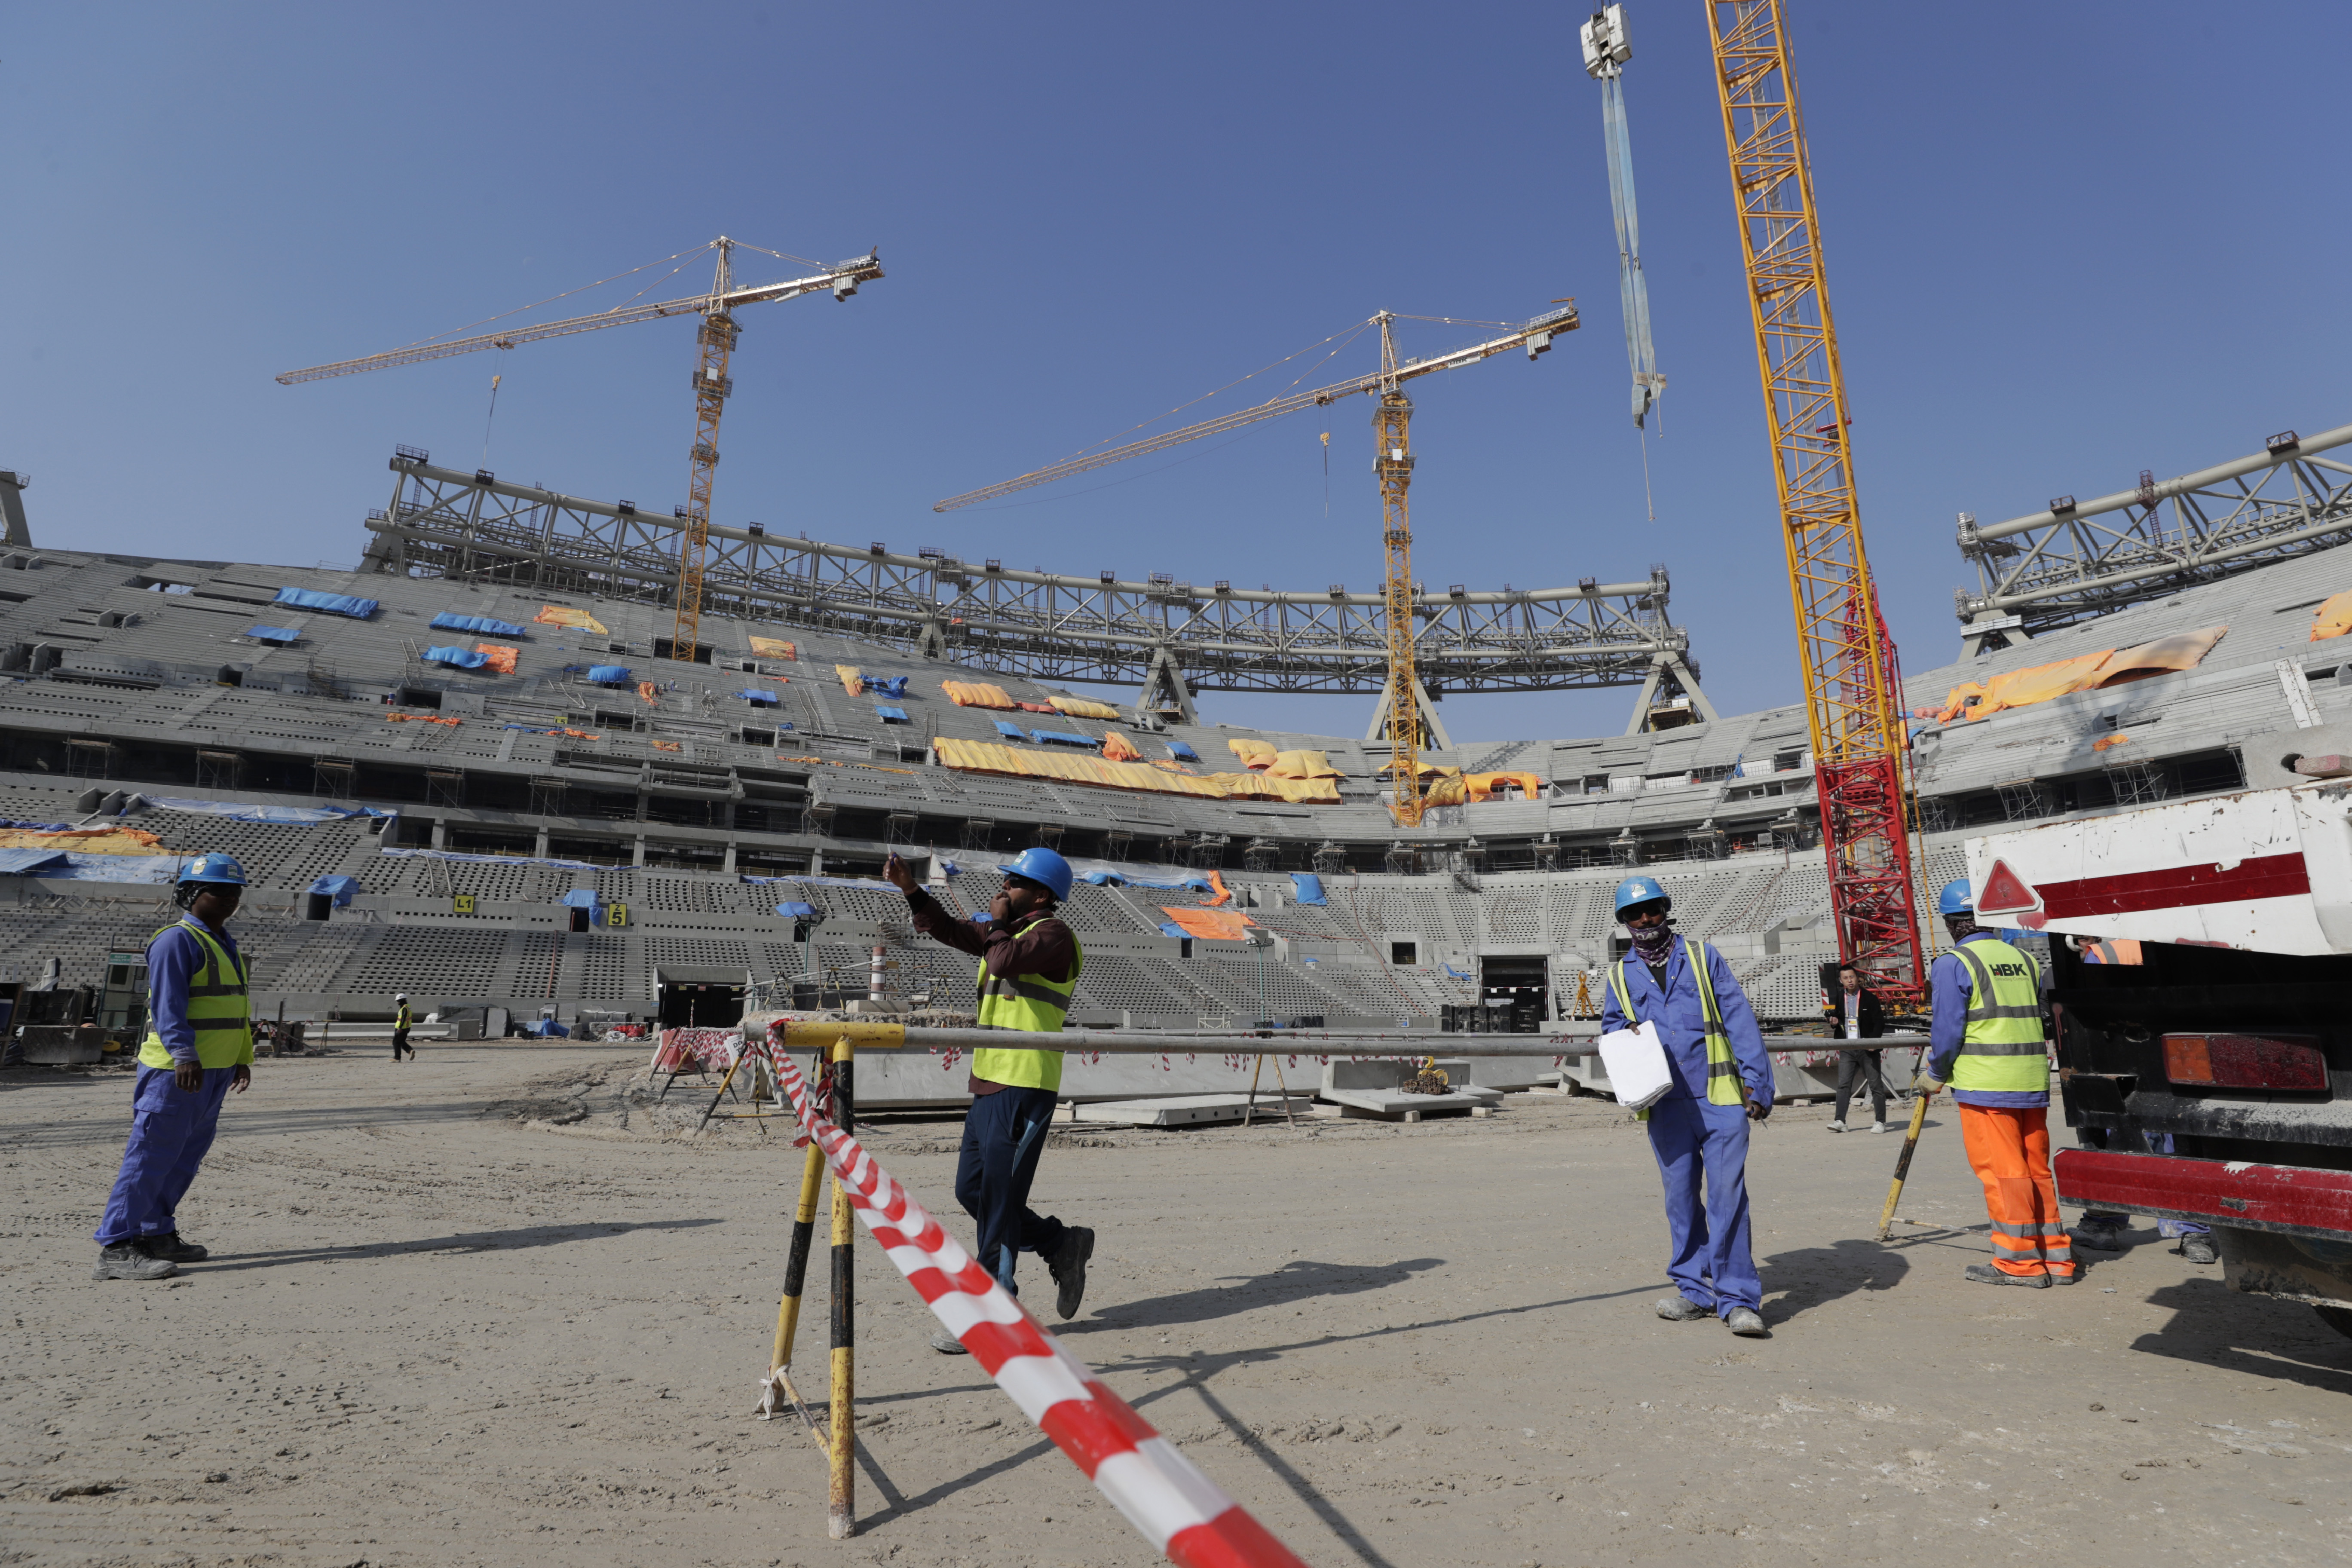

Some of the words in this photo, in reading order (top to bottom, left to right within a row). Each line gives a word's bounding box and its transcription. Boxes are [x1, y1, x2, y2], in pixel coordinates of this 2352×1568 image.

[457, 899, 471, 908] L1
[612, 912, 622, 925] 5
[1989, 964, 2027, 976] HBK
